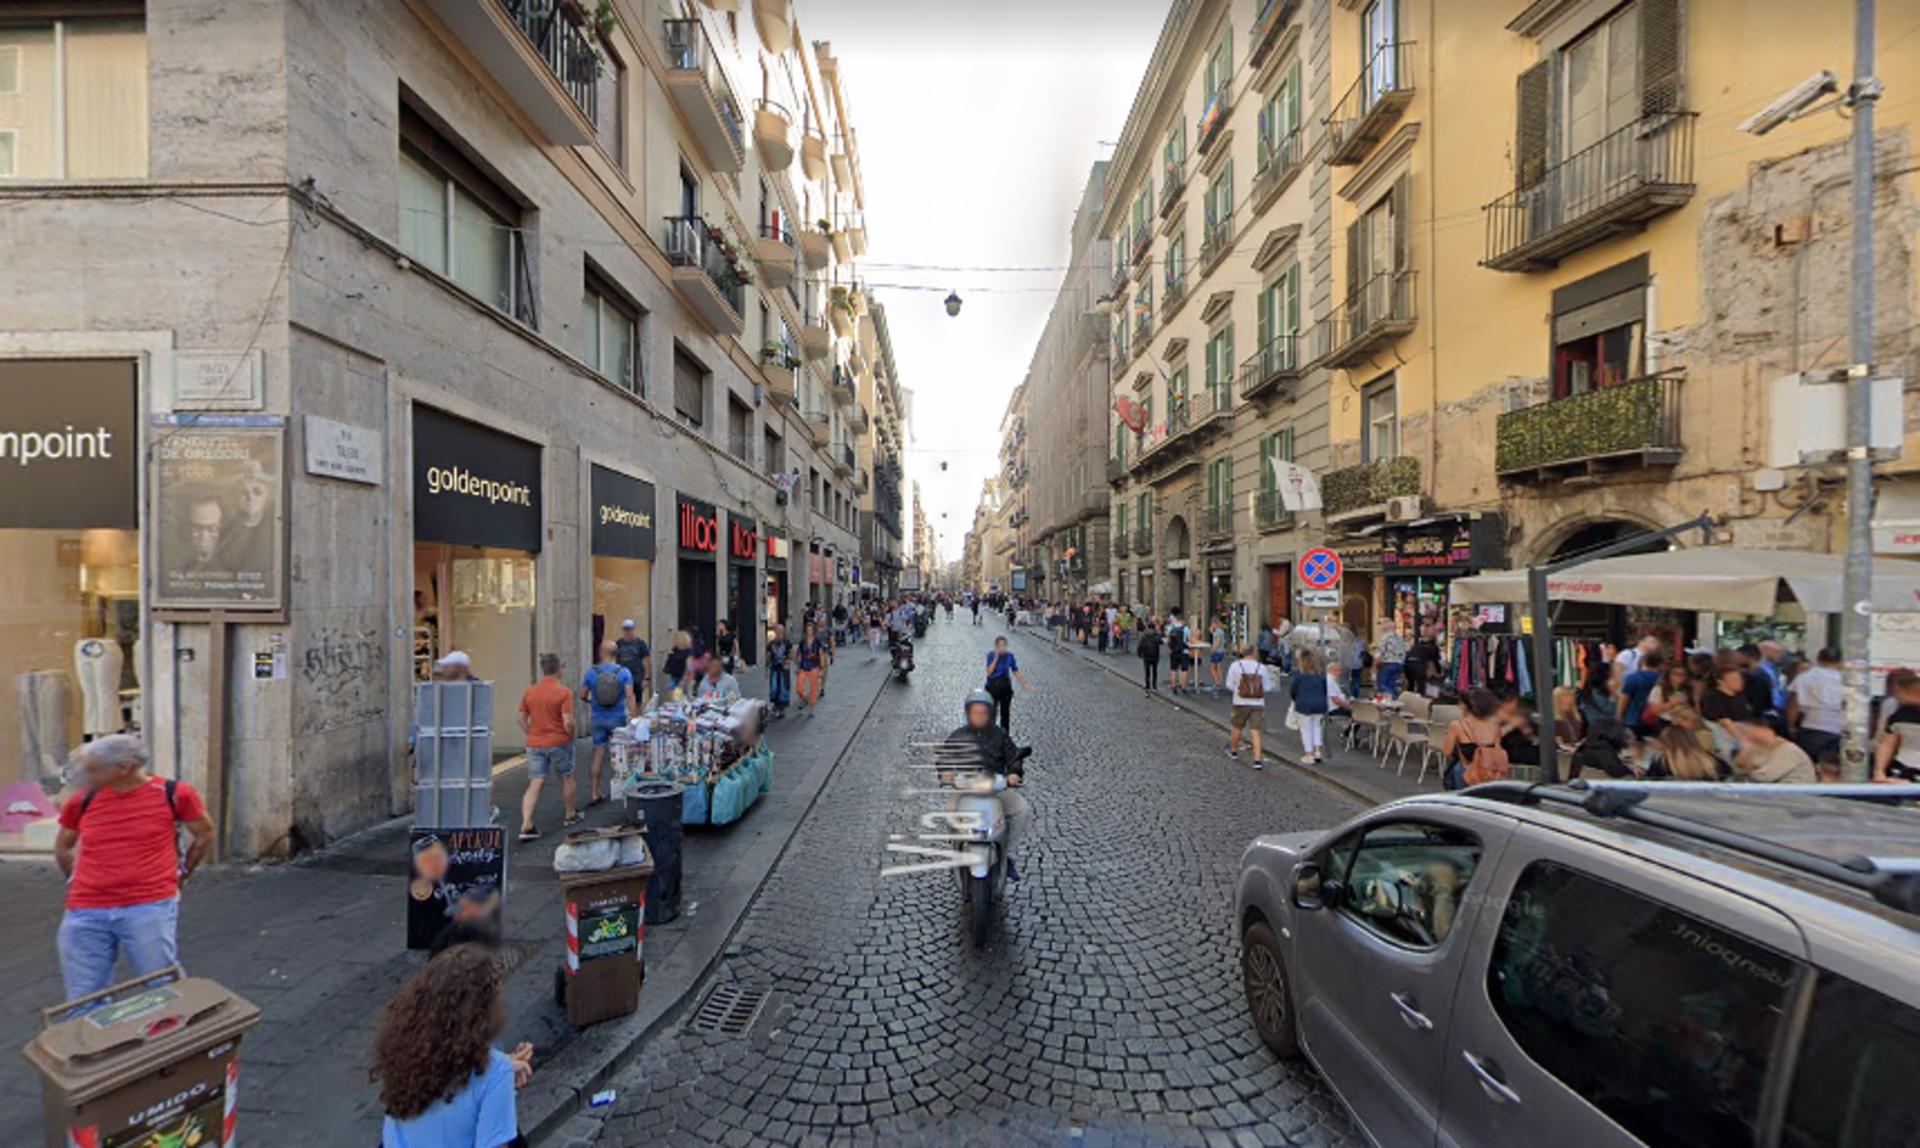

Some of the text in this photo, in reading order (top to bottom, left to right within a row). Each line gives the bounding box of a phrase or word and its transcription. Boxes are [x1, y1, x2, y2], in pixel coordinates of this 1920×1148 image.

[426, 465, 532, 507] goldenpoint
[599, 504, 651, 529] goldenpoint
[128, 1081, 209, 1126] UMIDO
